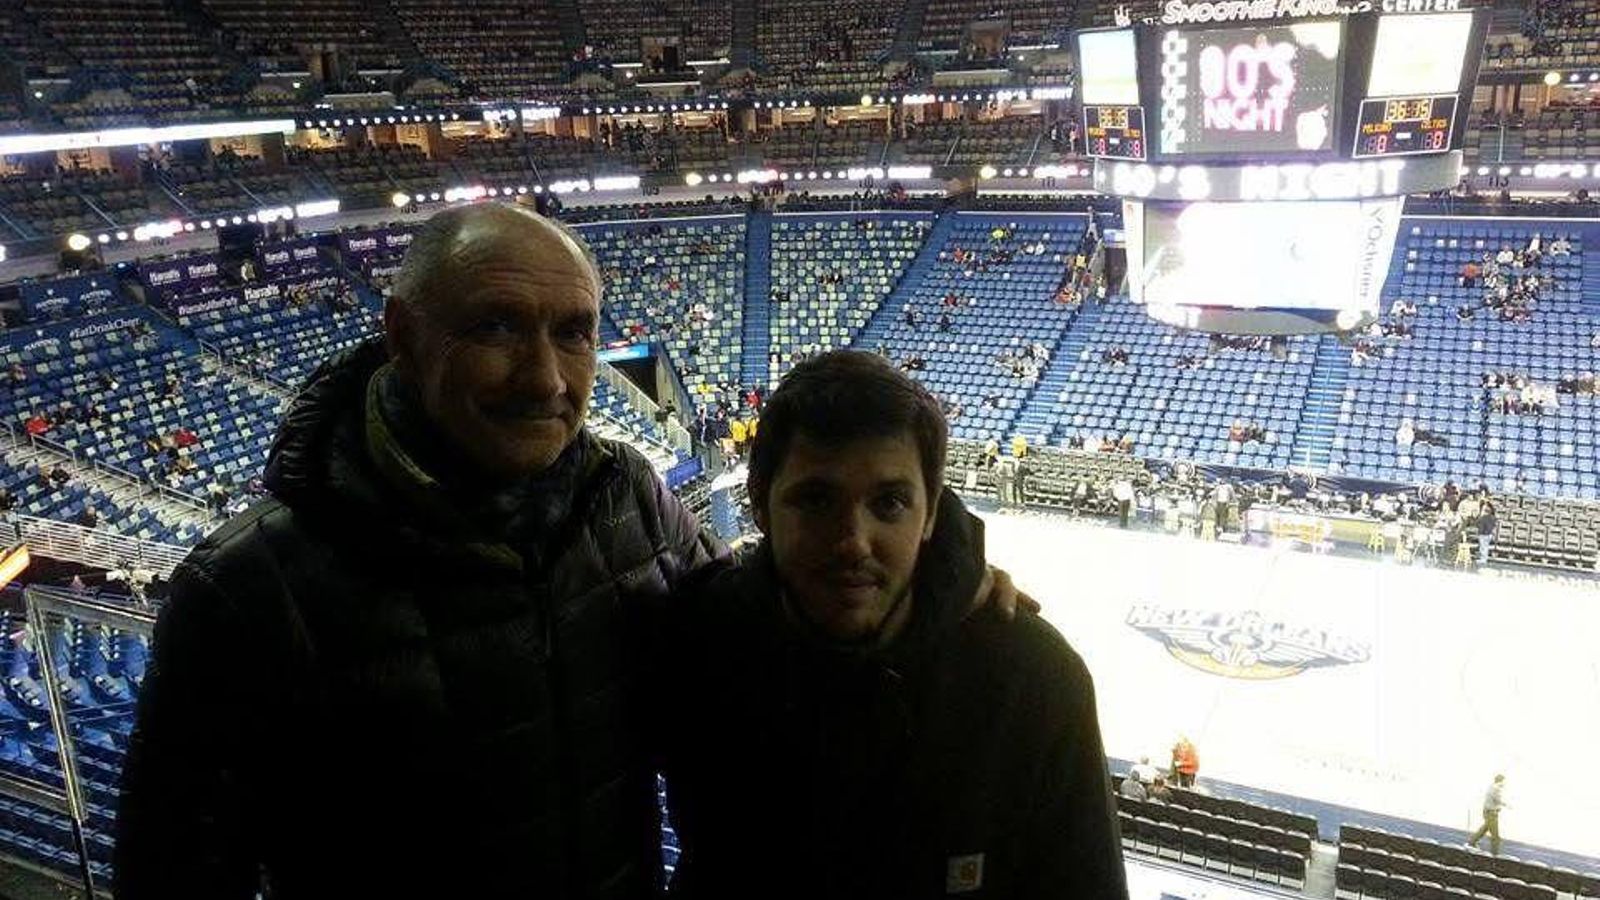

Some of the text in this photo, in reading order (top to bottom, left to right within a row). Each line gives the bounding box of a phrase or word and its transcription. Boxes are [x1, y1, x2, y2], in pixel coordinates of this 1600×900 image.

[1161, 0, 1275, 24] SMOOTHIE
[1382, 0, 1458, 12] CENTER
[1203, 98, 1290, 132] NIGHT
[1240, 160, 1405, 199] NIGHT
